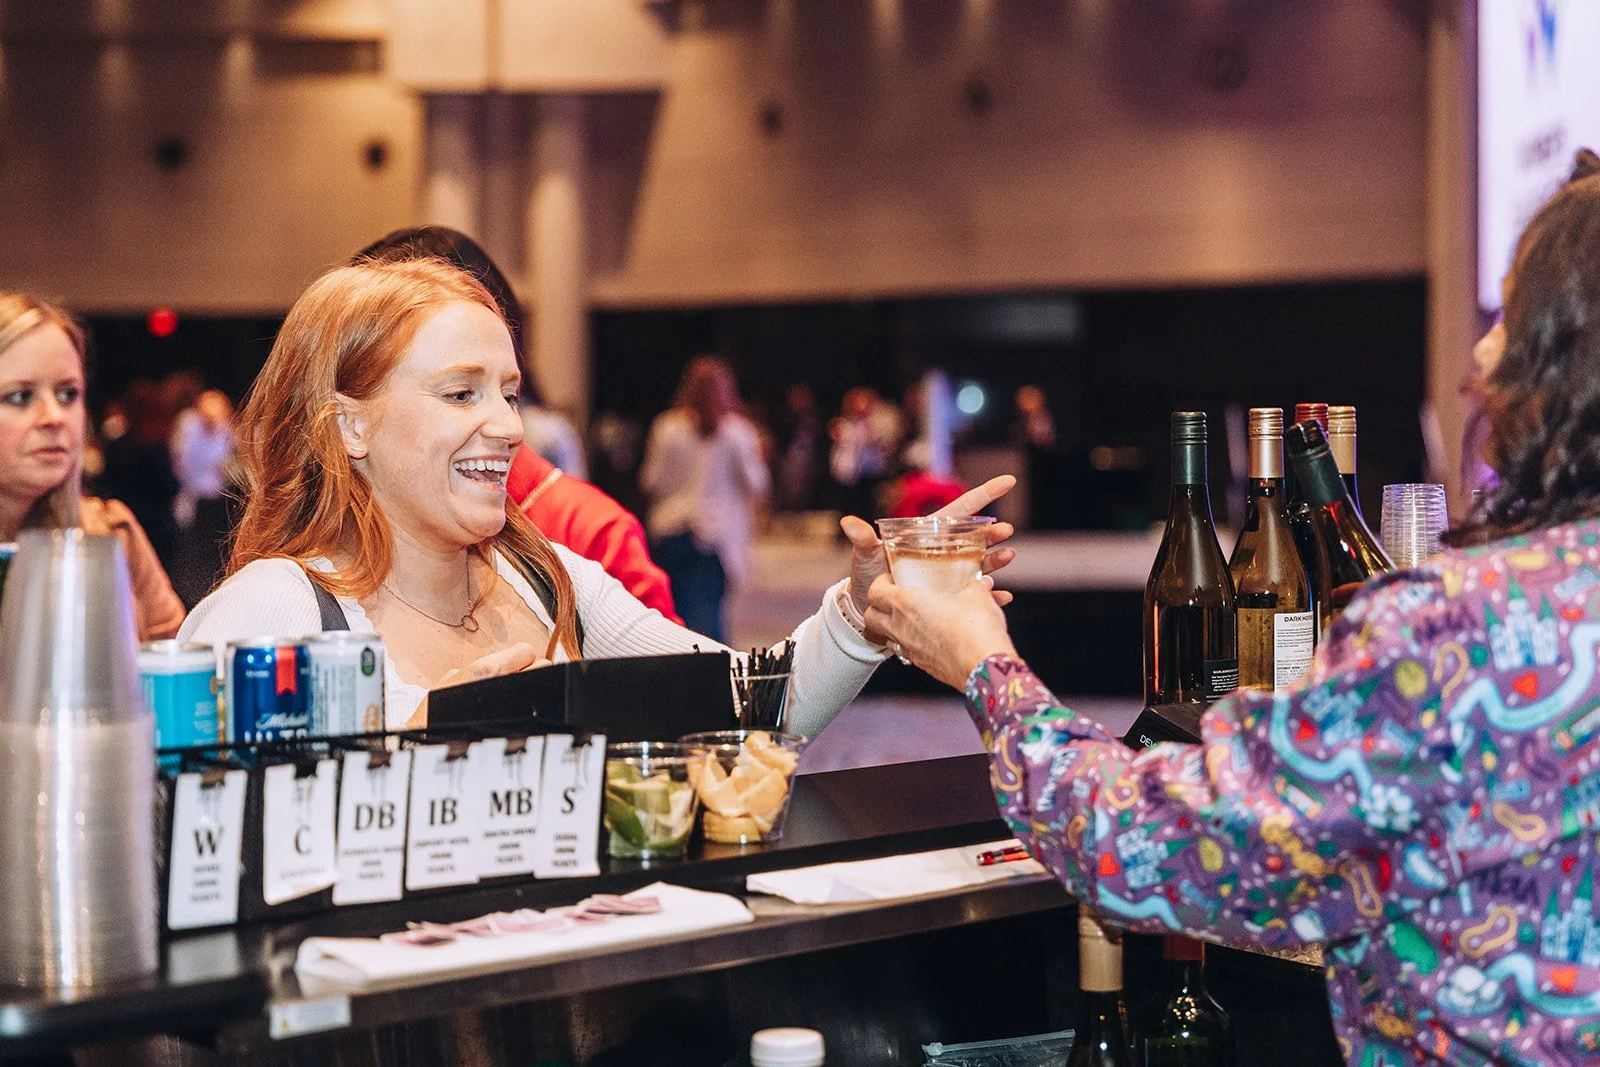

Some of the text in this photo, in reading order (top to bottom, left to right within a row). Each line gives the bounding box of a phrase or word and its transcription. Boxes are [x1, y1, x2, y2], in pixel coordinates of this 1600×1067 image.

[1140, 735, 1158, 748] DEV
[429, 797, 457, 826] IB
[489, 788, 532, 817] MB
[561, 786, 576, 814] S
[355, 801, 395, 831] DB
[194, 826, 223, 855] W
[294, 824, 311, 855] C
